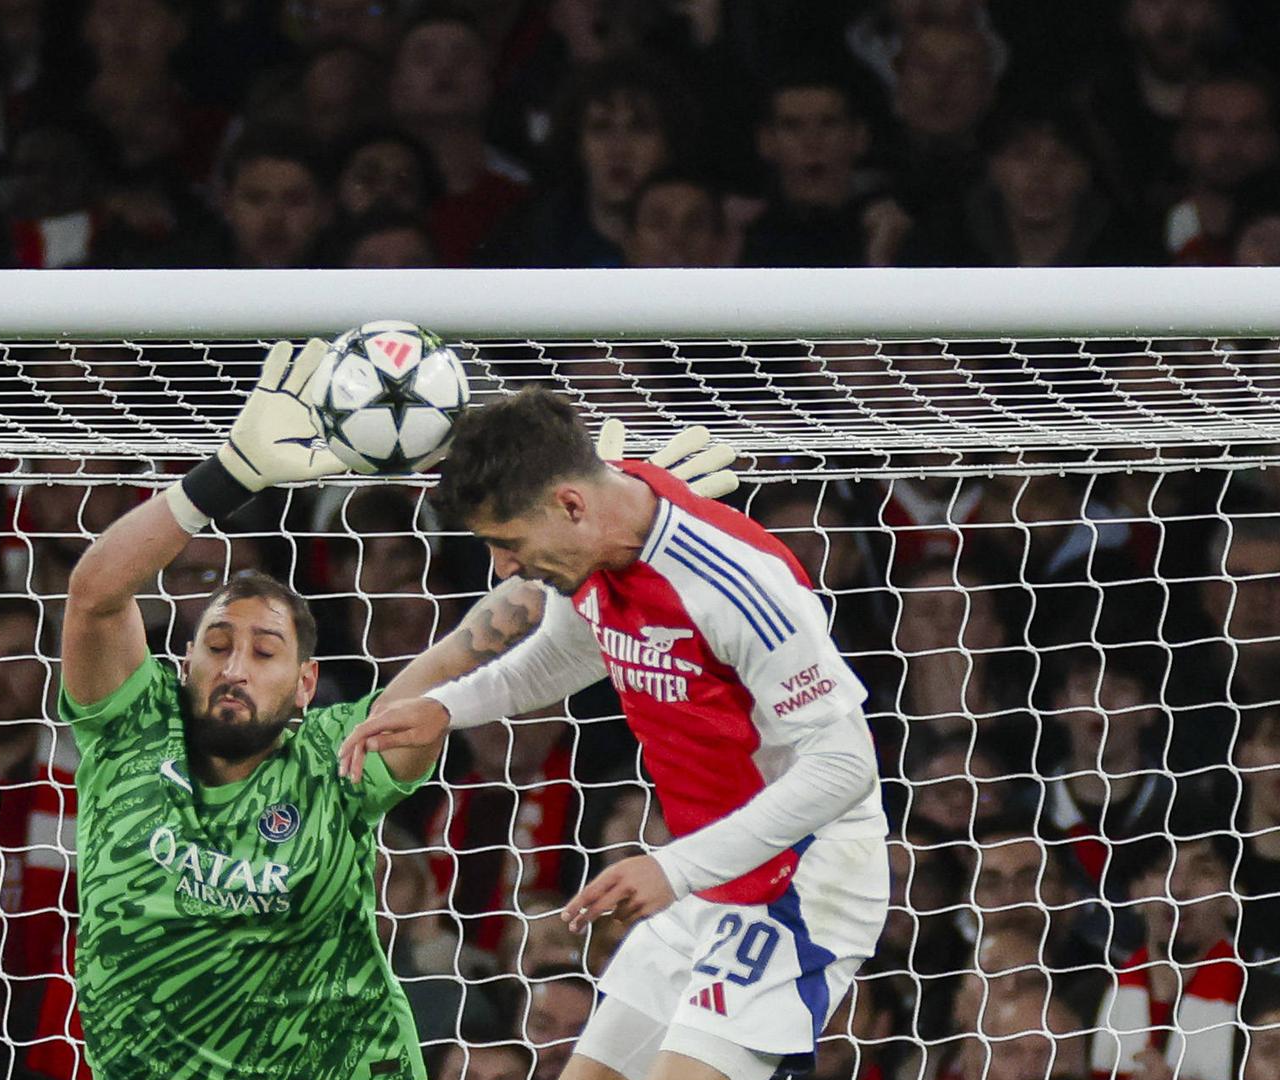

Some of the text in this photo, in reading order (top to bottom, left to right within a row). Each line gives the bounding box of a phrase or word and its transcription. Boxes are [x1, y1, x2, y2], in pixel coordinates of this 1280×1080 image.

[780, 663, 821, 693] VISIT
[773, 679, 838, 718] RWAND
[149, 827, 291, 894] QATAR
[175, 875, 291, 914] AIRWAYS
[693, 912, 780, 986] 29
